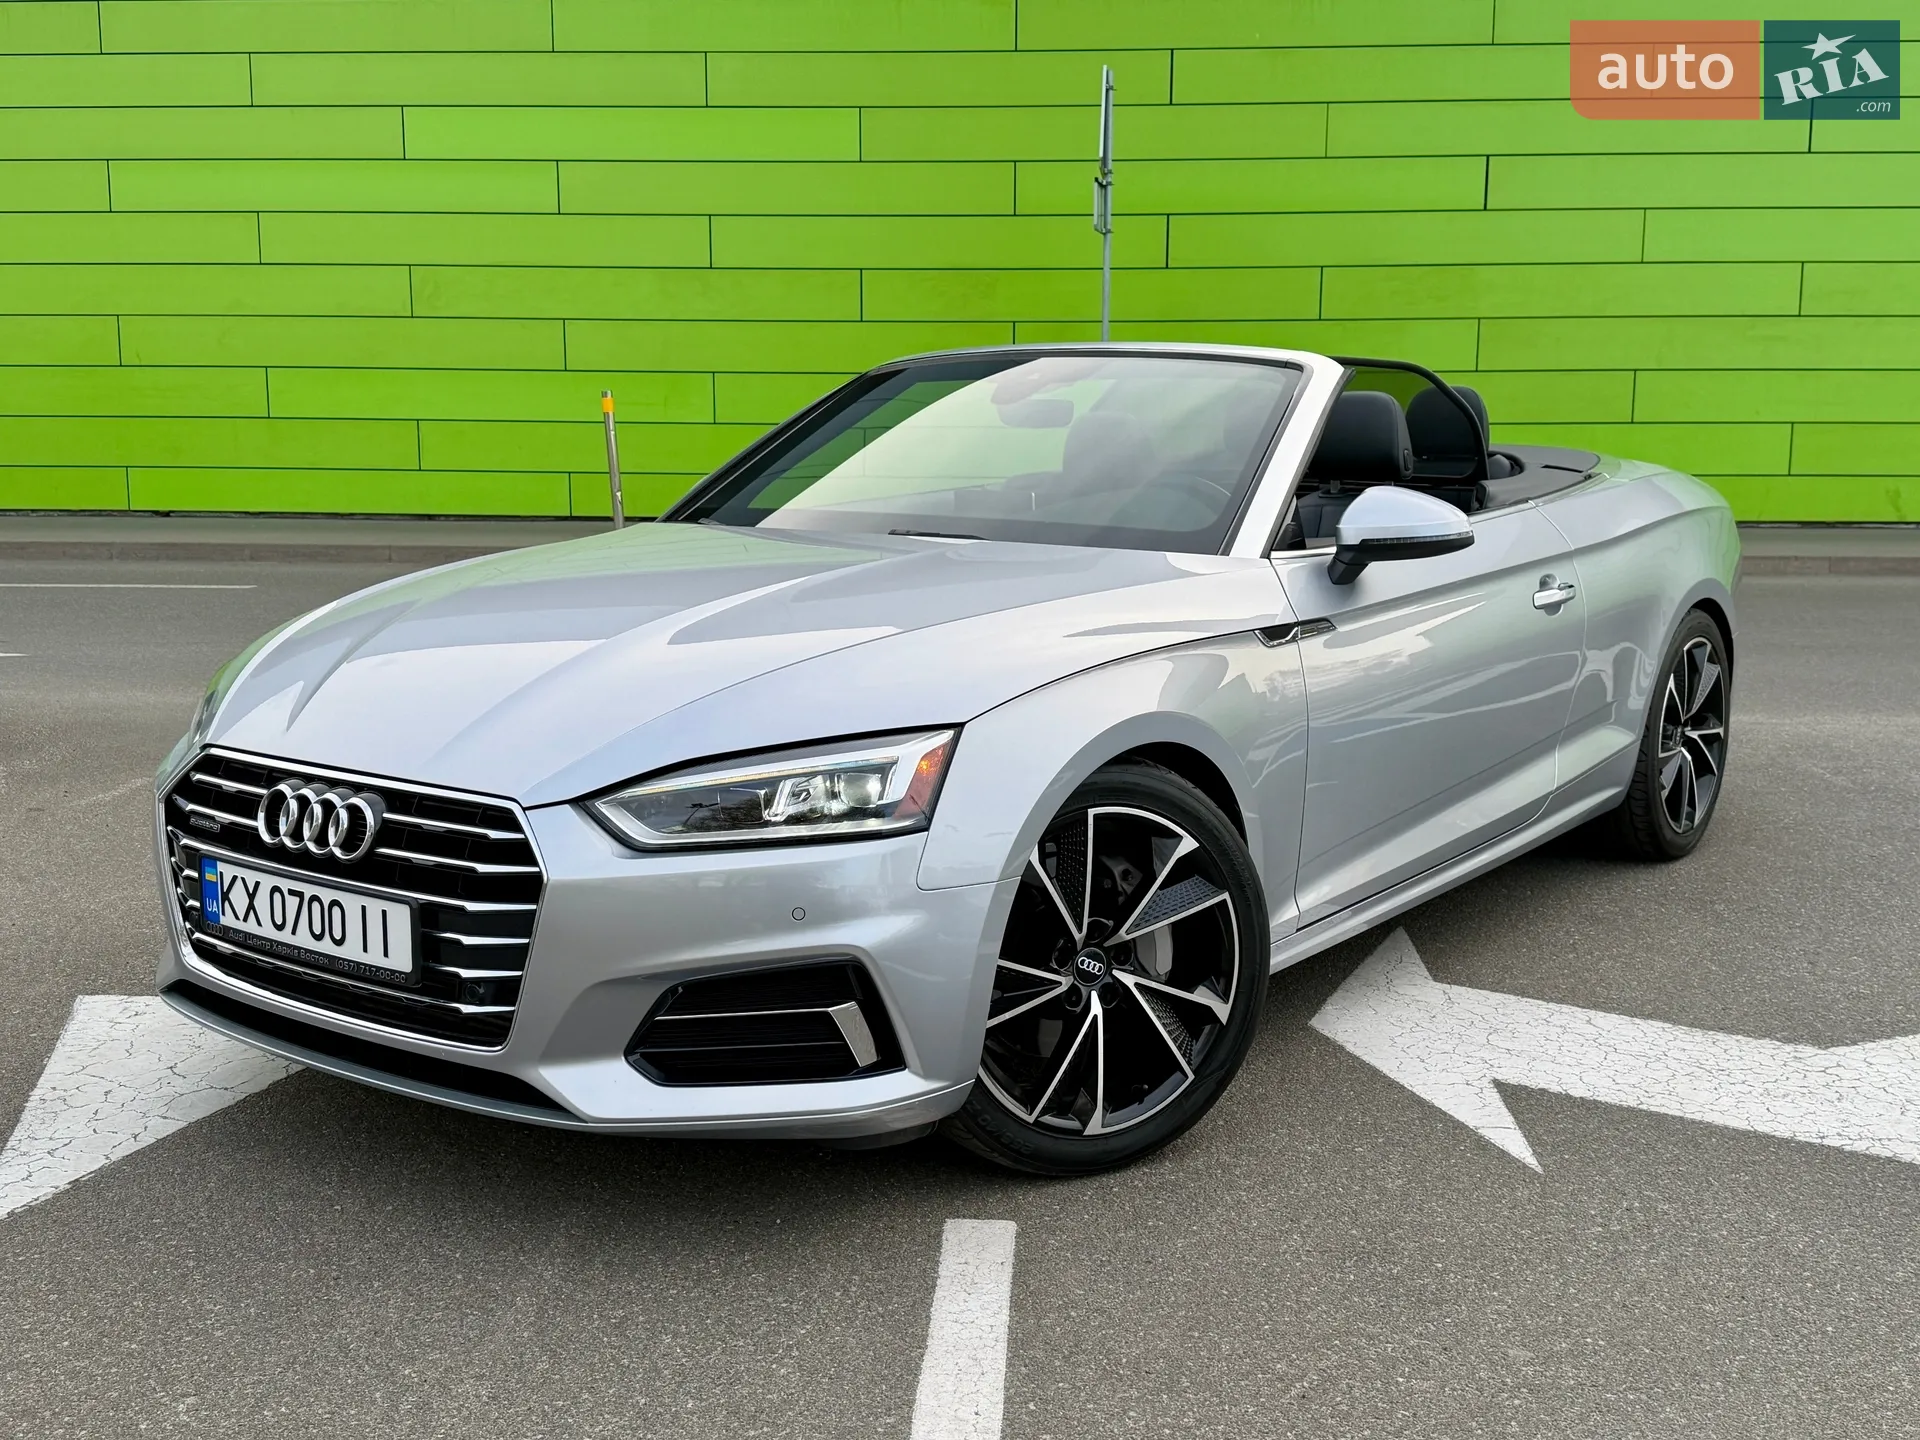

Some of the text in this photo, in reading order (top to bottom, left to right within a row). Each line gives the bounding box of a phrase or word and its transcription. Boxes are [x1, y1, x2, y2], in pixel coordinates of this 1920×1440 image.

[206, 897, 219, 914] UA
[219, 870, 263, 928] KX
[269, 884, 347, 948] 0700
[228, 928, 246, 943] Audi
[246, 933, 272, 951] Центр
[300, 949, 330, 966] Восток
[335, 958, 359, 974] (057)
[359, 963, 407, 984] 717-00-00
